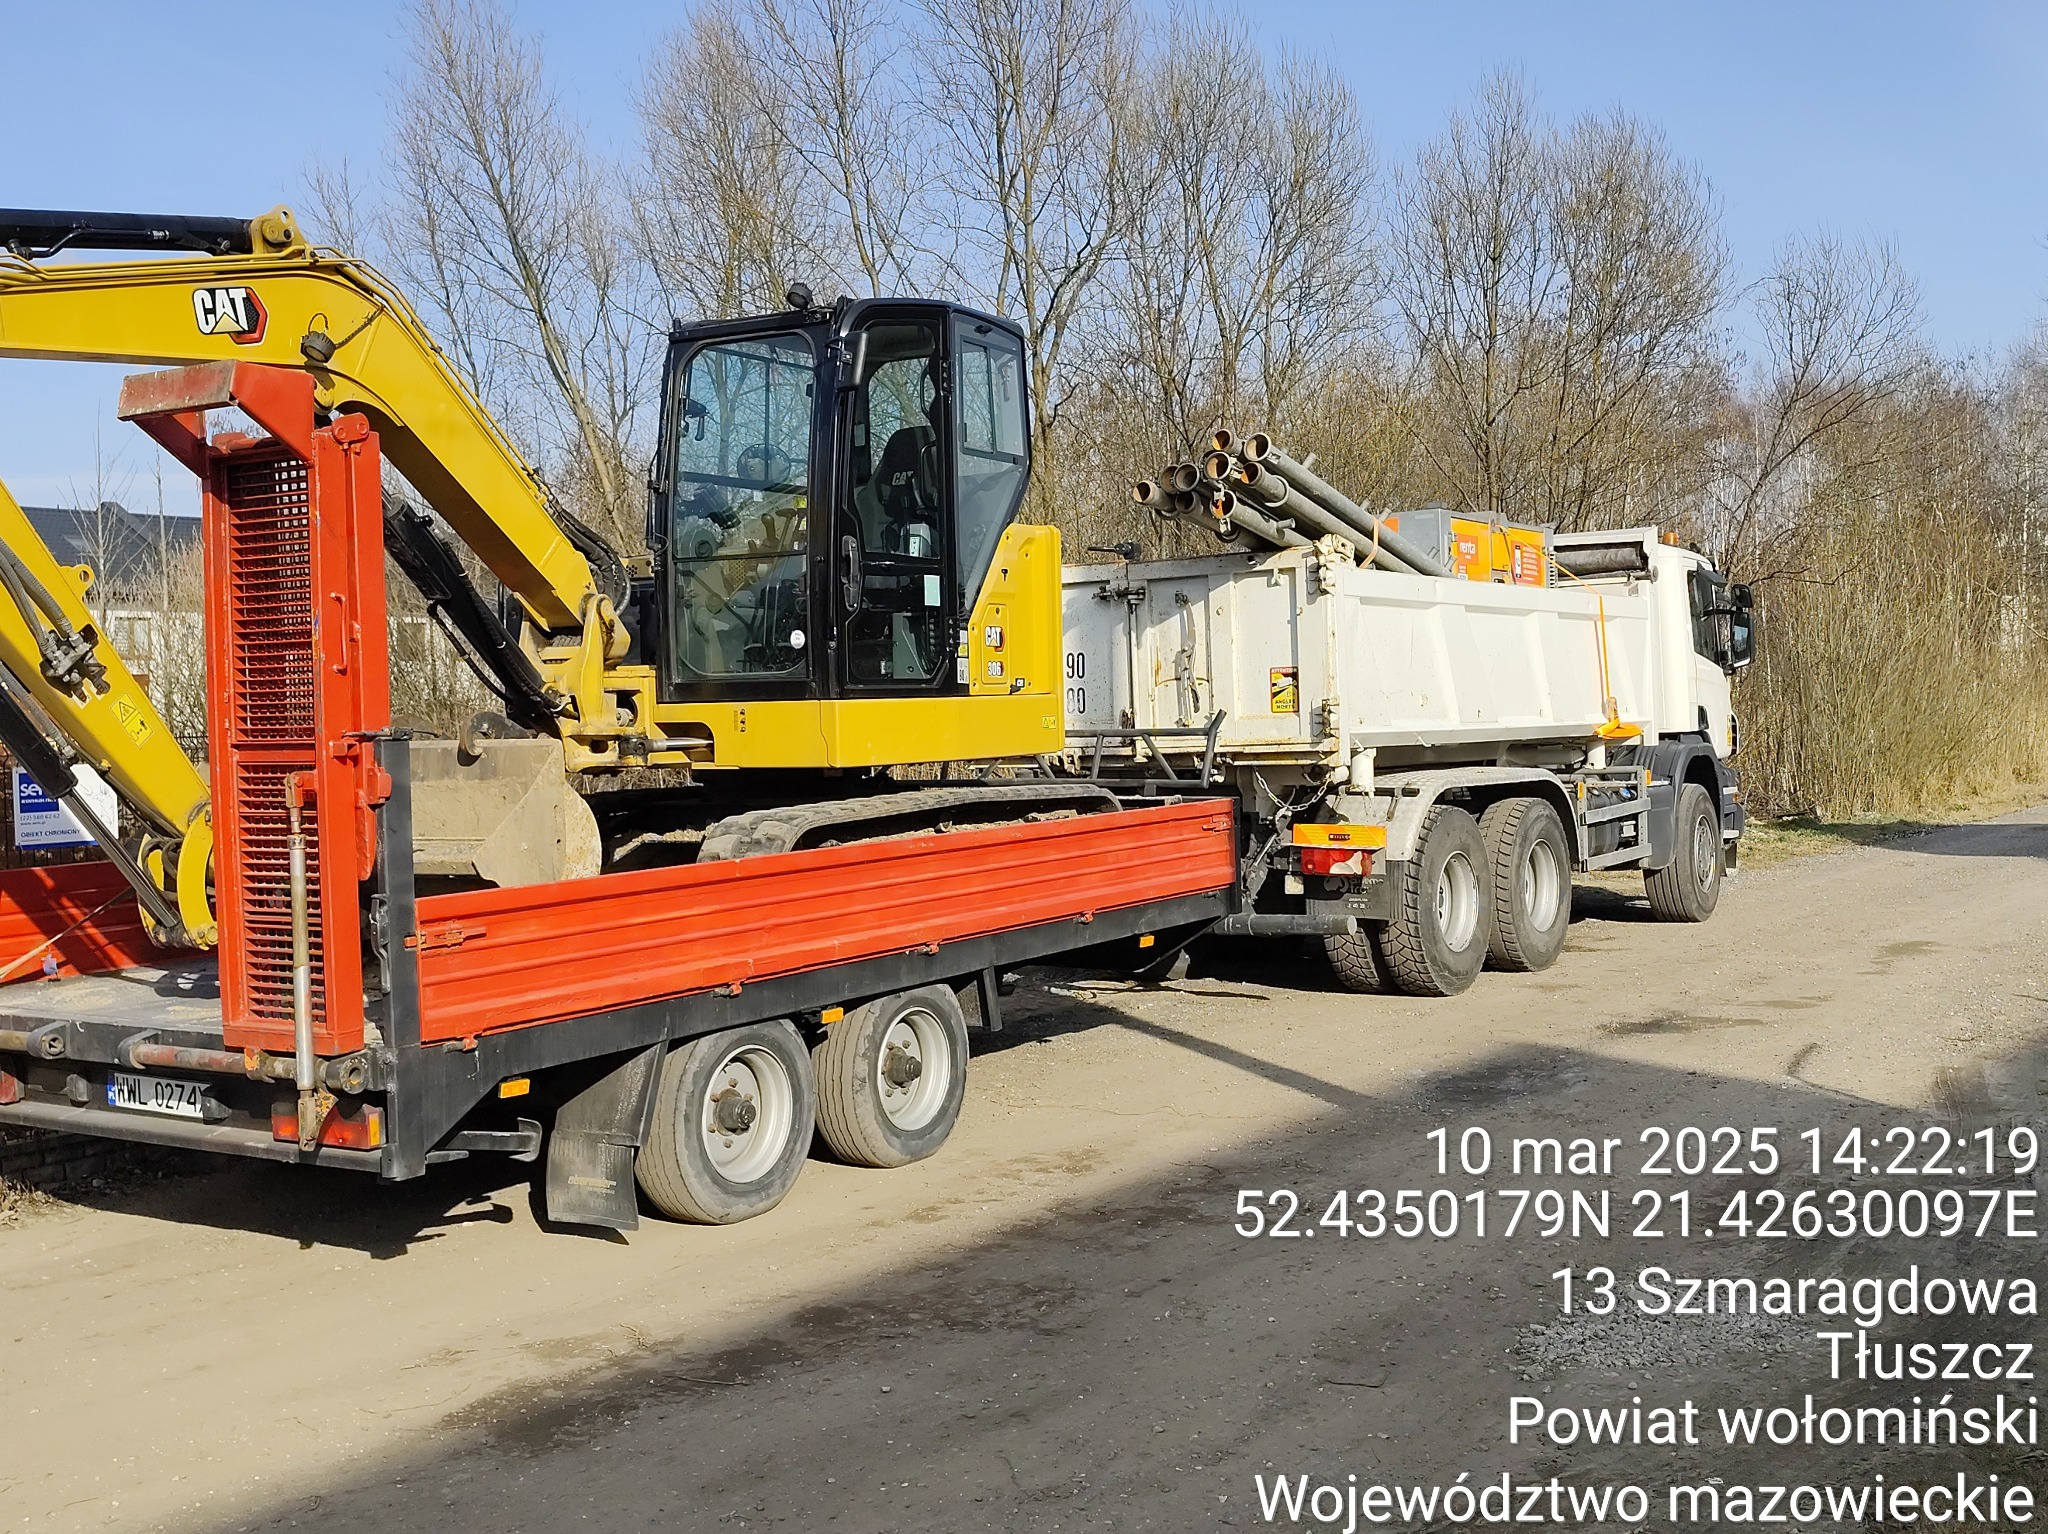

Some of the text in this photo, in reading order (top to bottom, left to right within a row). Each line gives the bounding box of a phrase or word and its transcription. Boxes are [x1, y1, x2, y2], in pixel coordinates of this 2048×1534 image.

[193, 287, 249, 334] CAT
[891, 470, 915, 486] CAT
[1459, 540, 1476, 555] renta
[985, 626, 1002, 648] CAT
[987, 660, 1003, 676] 306
[1066, 652, 1085, 679] 90
[116, 1076, 148, 1106] WWL
